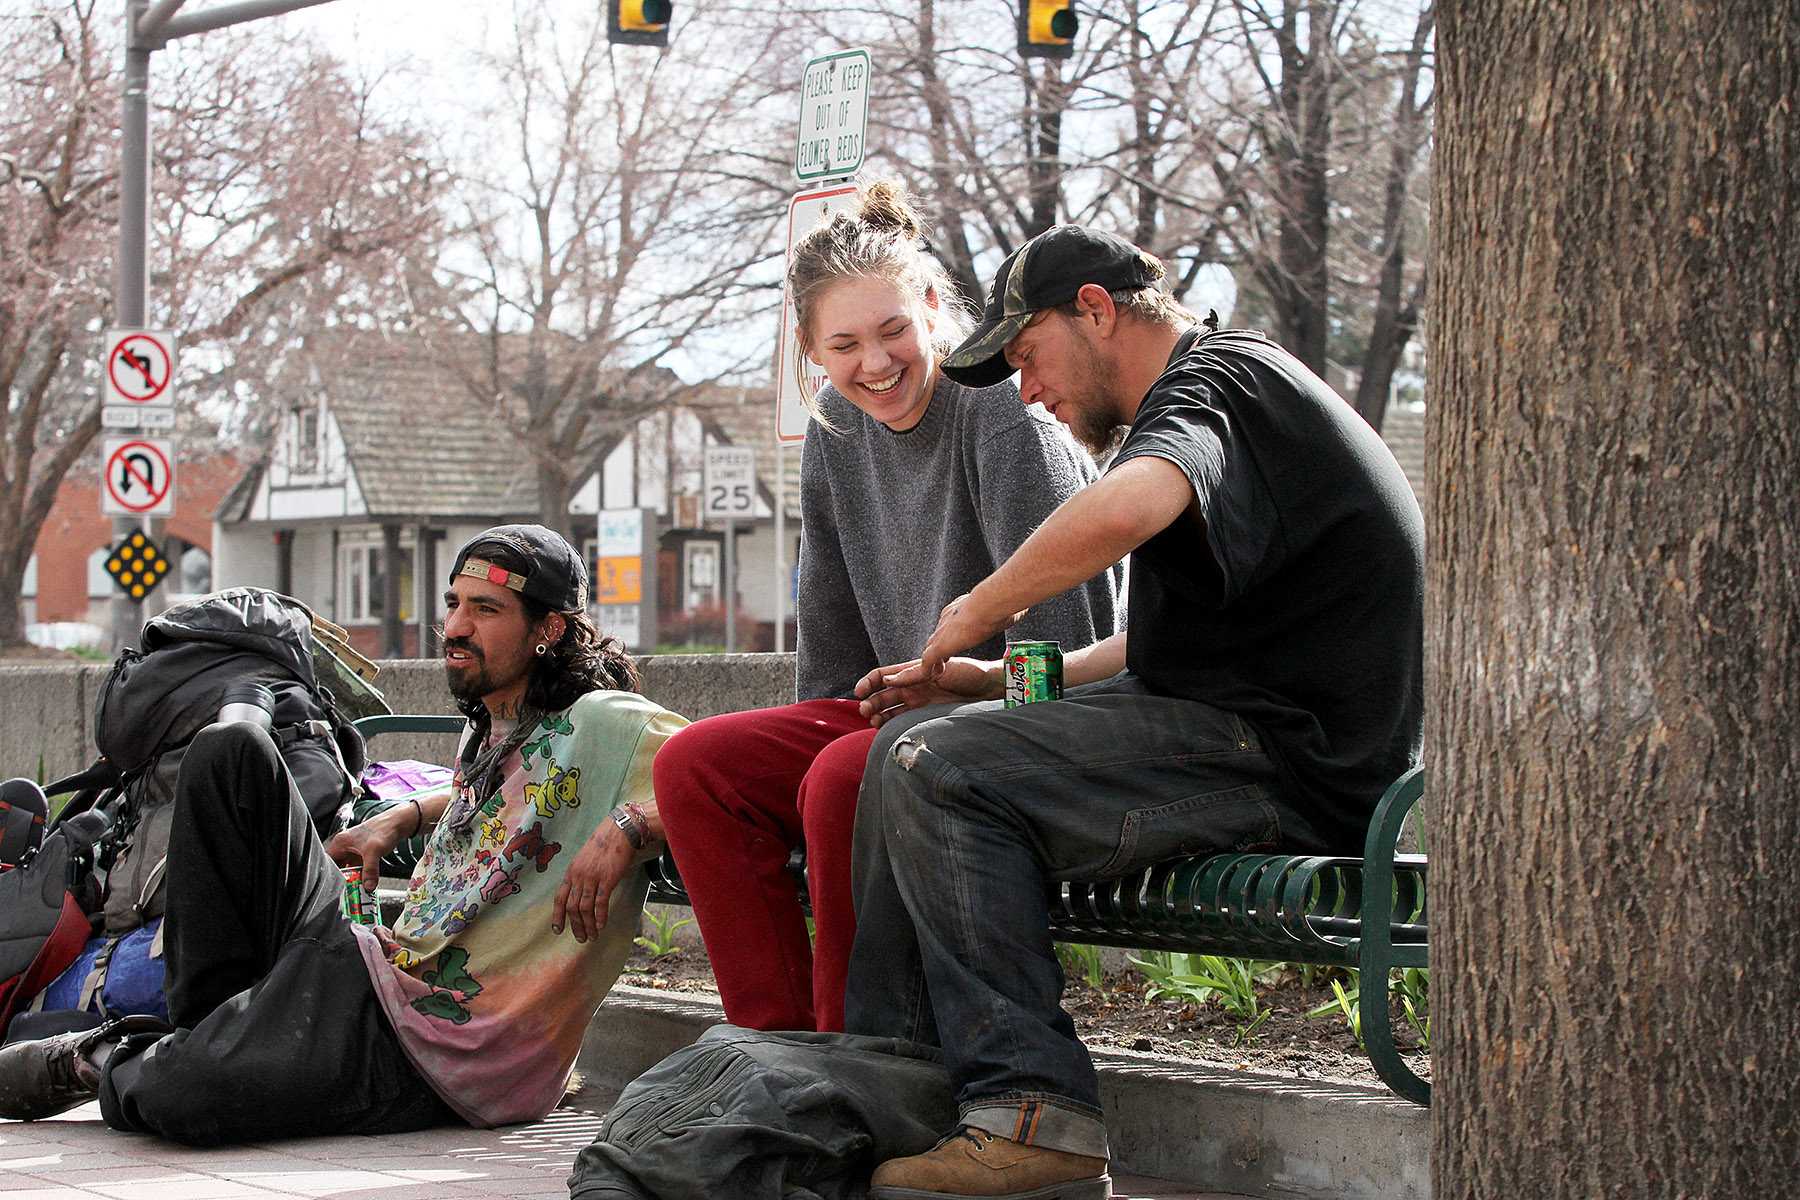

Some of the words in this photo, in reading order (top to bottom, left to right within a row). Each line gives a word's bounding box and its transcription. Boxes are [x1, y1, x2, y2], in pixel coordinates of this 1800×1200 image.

[805, 69, 833, 99] PLEASE
[841, 63, 864, 92] KEEP
[815, 103, 831, 131] OUT
[838, 100, 850, 127] OF
[800, 138, 830, 168] FLOWER
[837, 134, 859, 162] BEDS
[710, 453, 751, 466] SPEED
[711, 485, 751, 511] 25
